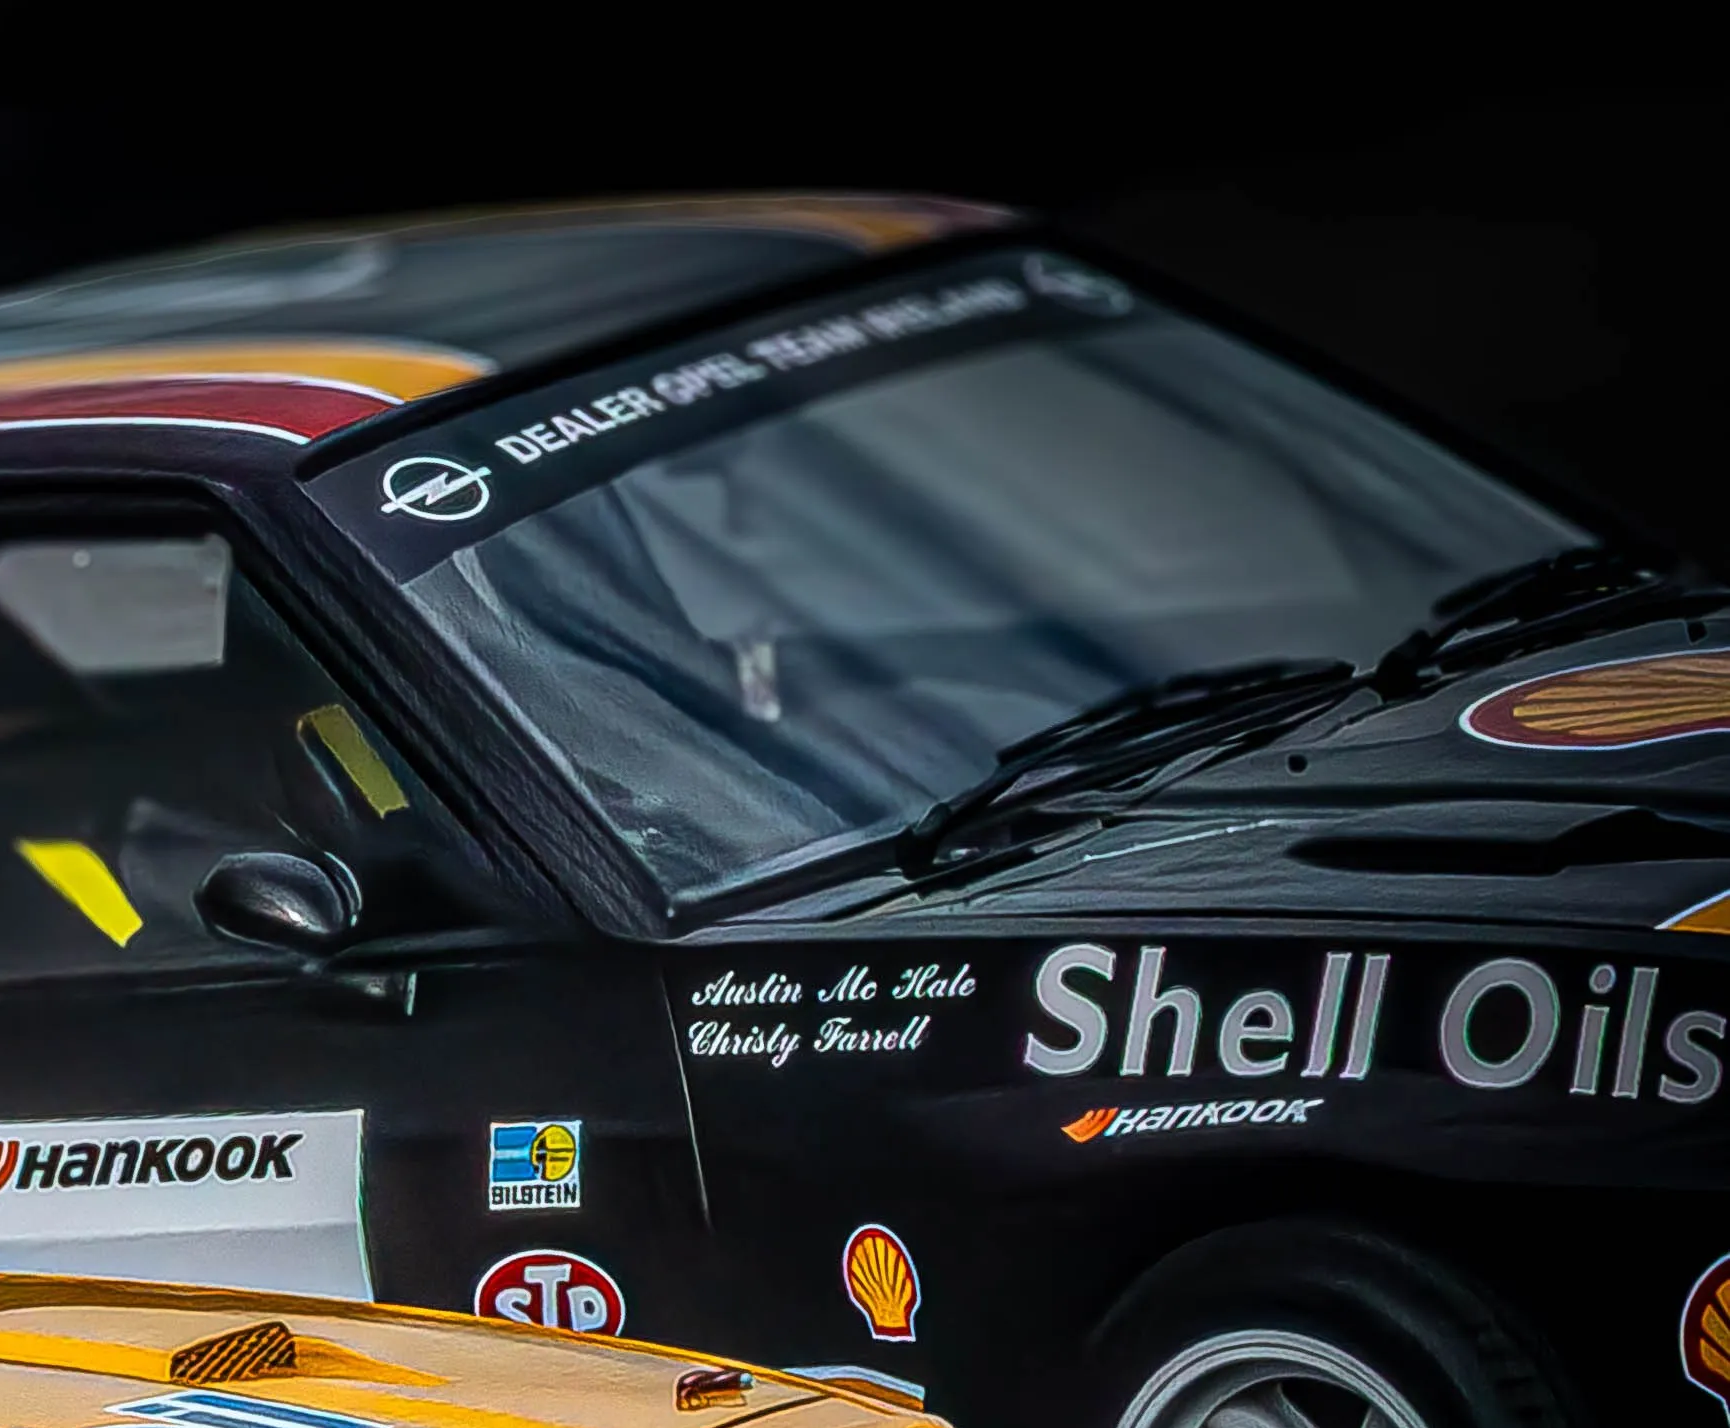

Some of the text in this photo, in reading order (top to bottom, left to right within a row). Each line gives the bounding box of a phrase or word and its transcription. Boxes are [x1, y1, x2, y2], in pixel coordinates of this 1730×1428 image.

[495, 386, 664, 464] DEALER
[692, 970, 803, 1006] Austin
[892, 963, 977, 999] Hale
[689, 1015, 931, 1068] Christy Farrell
[1024, 943, 1728, 1104] Shell Oils
[492, 1183, 577, 1205] BILSTEIN
[495, 1264, 608, 1334] STP
